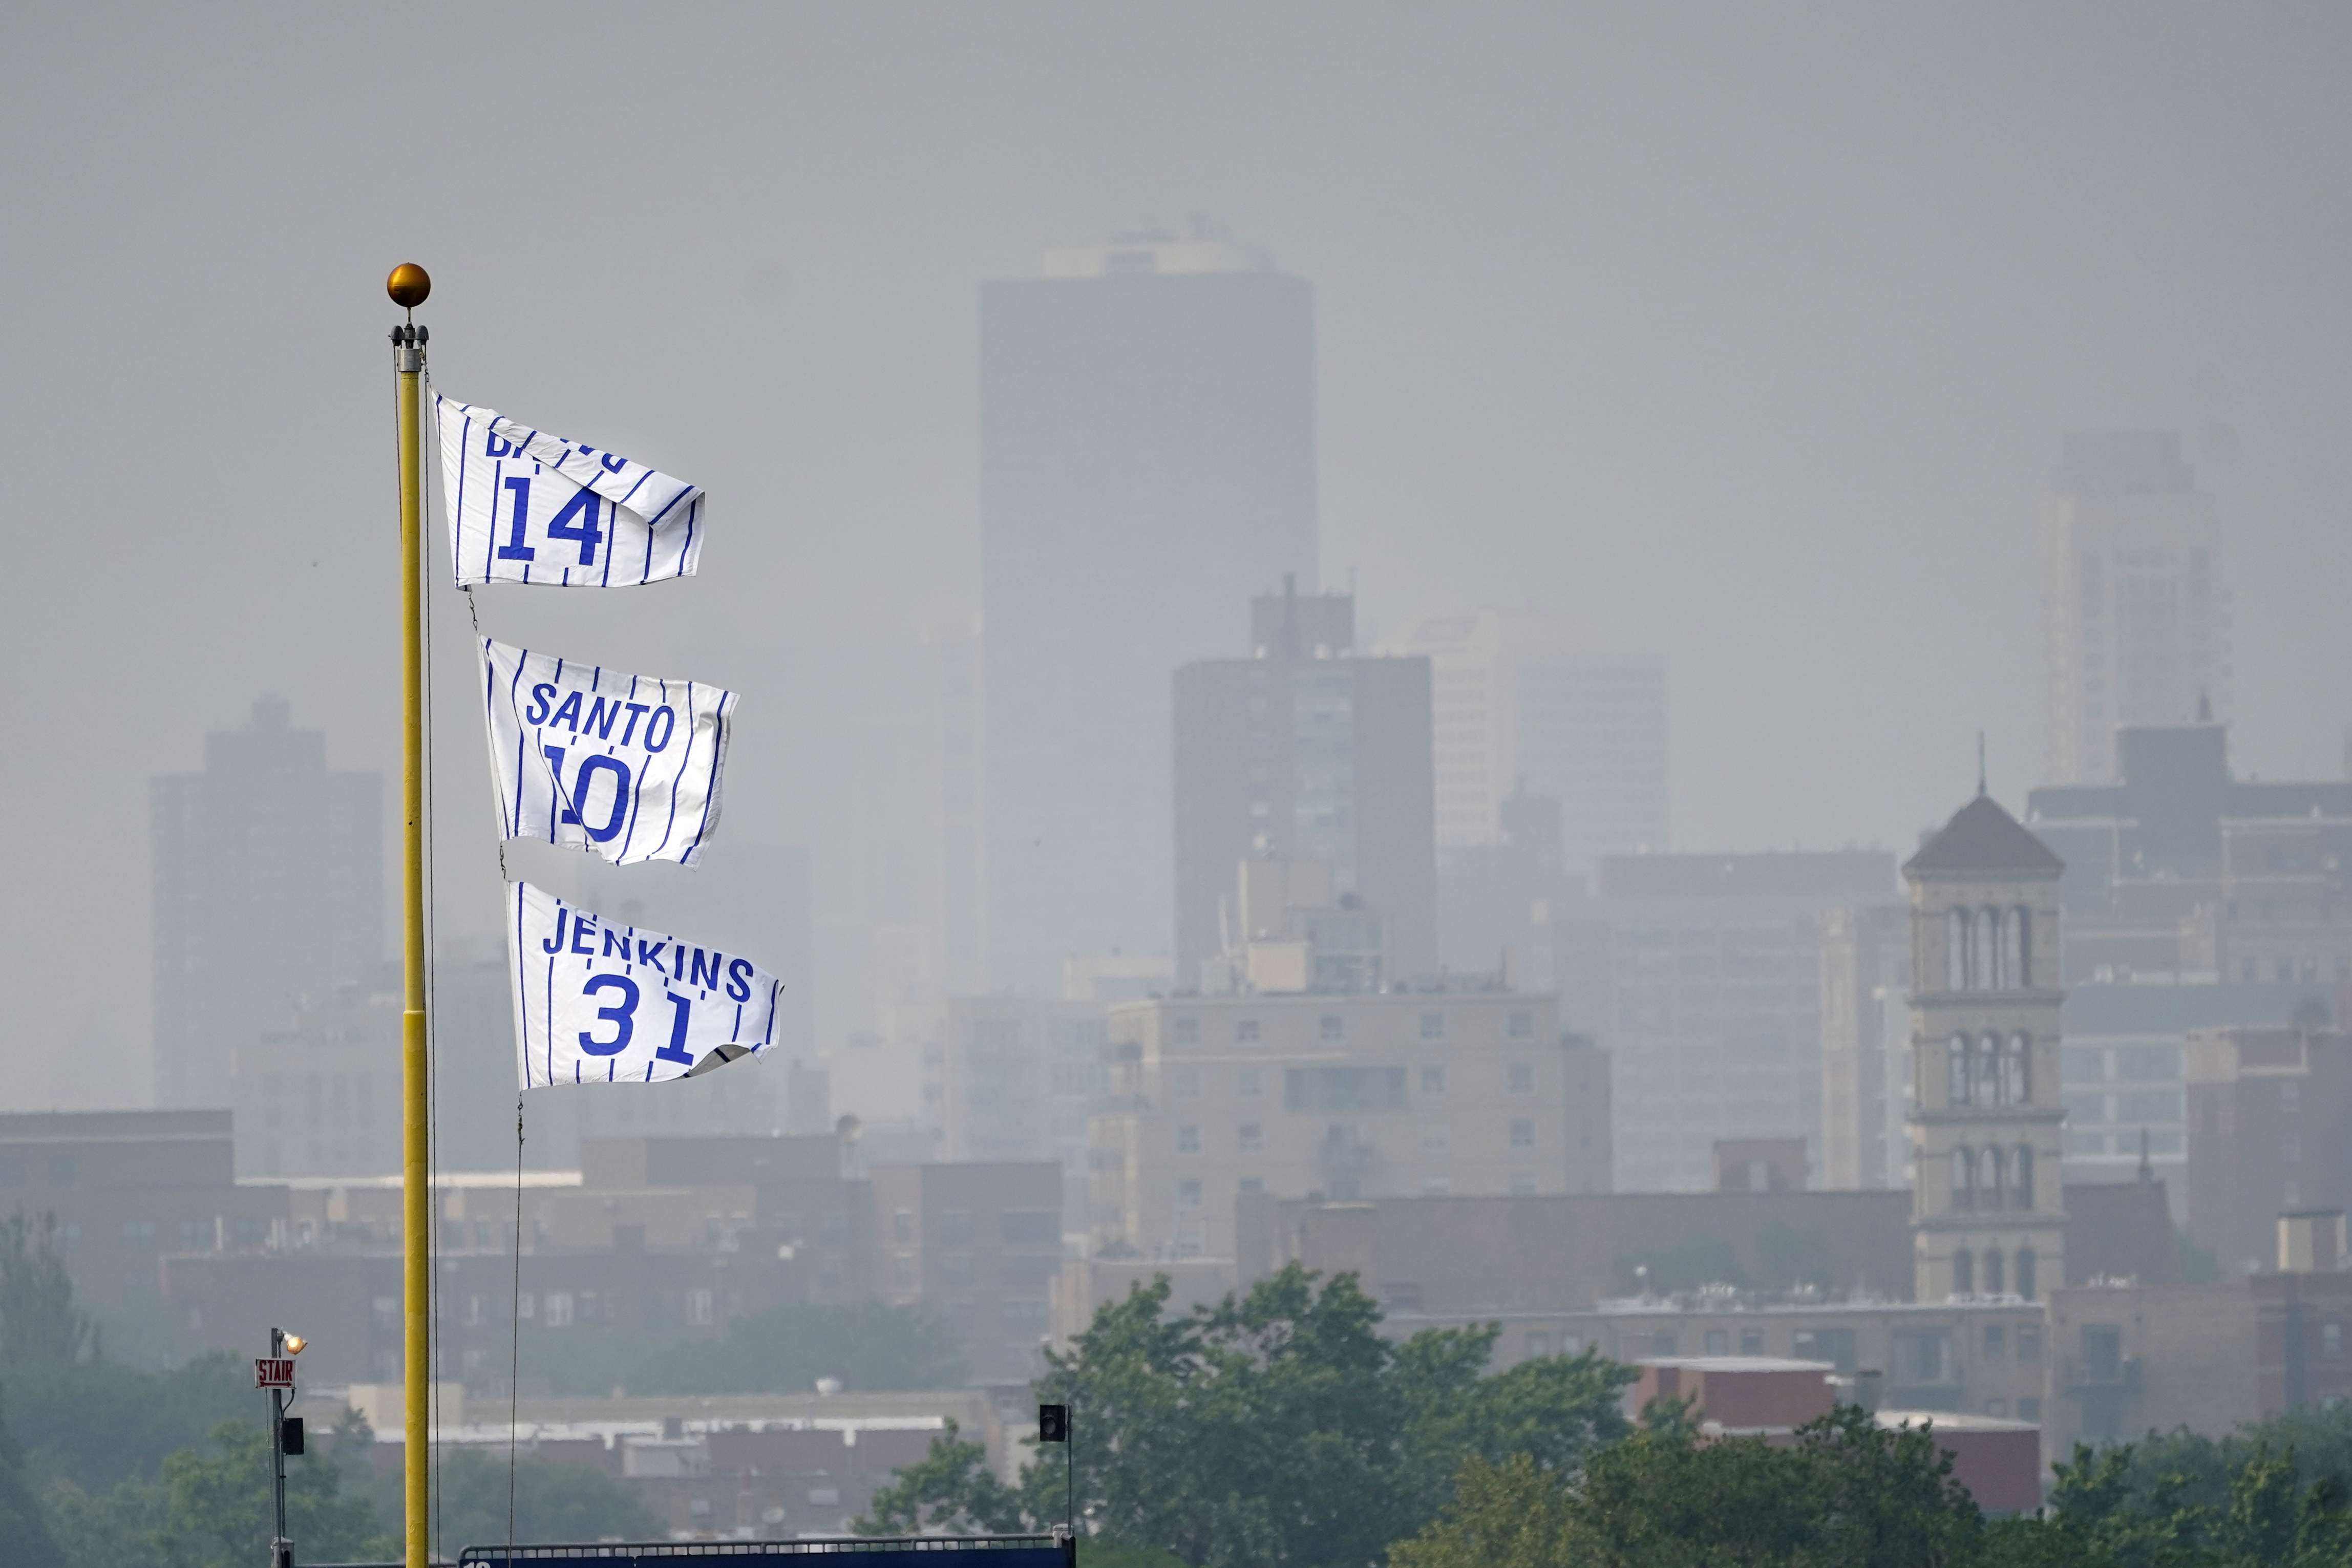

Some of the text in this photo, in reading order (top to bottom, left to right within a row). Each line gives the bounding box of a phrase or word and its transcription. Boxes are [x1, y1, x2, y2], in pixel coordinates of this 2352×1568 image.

[498, 477, 602, 566] 14
[526, 683, 675, 753] SANTO
[544, 745, 631, 842] 10
[543, 908, 753, 1002] JENKINS
[579, 974, 694, 1065] 31
[259, 1360, 292, 1381] STAIR
